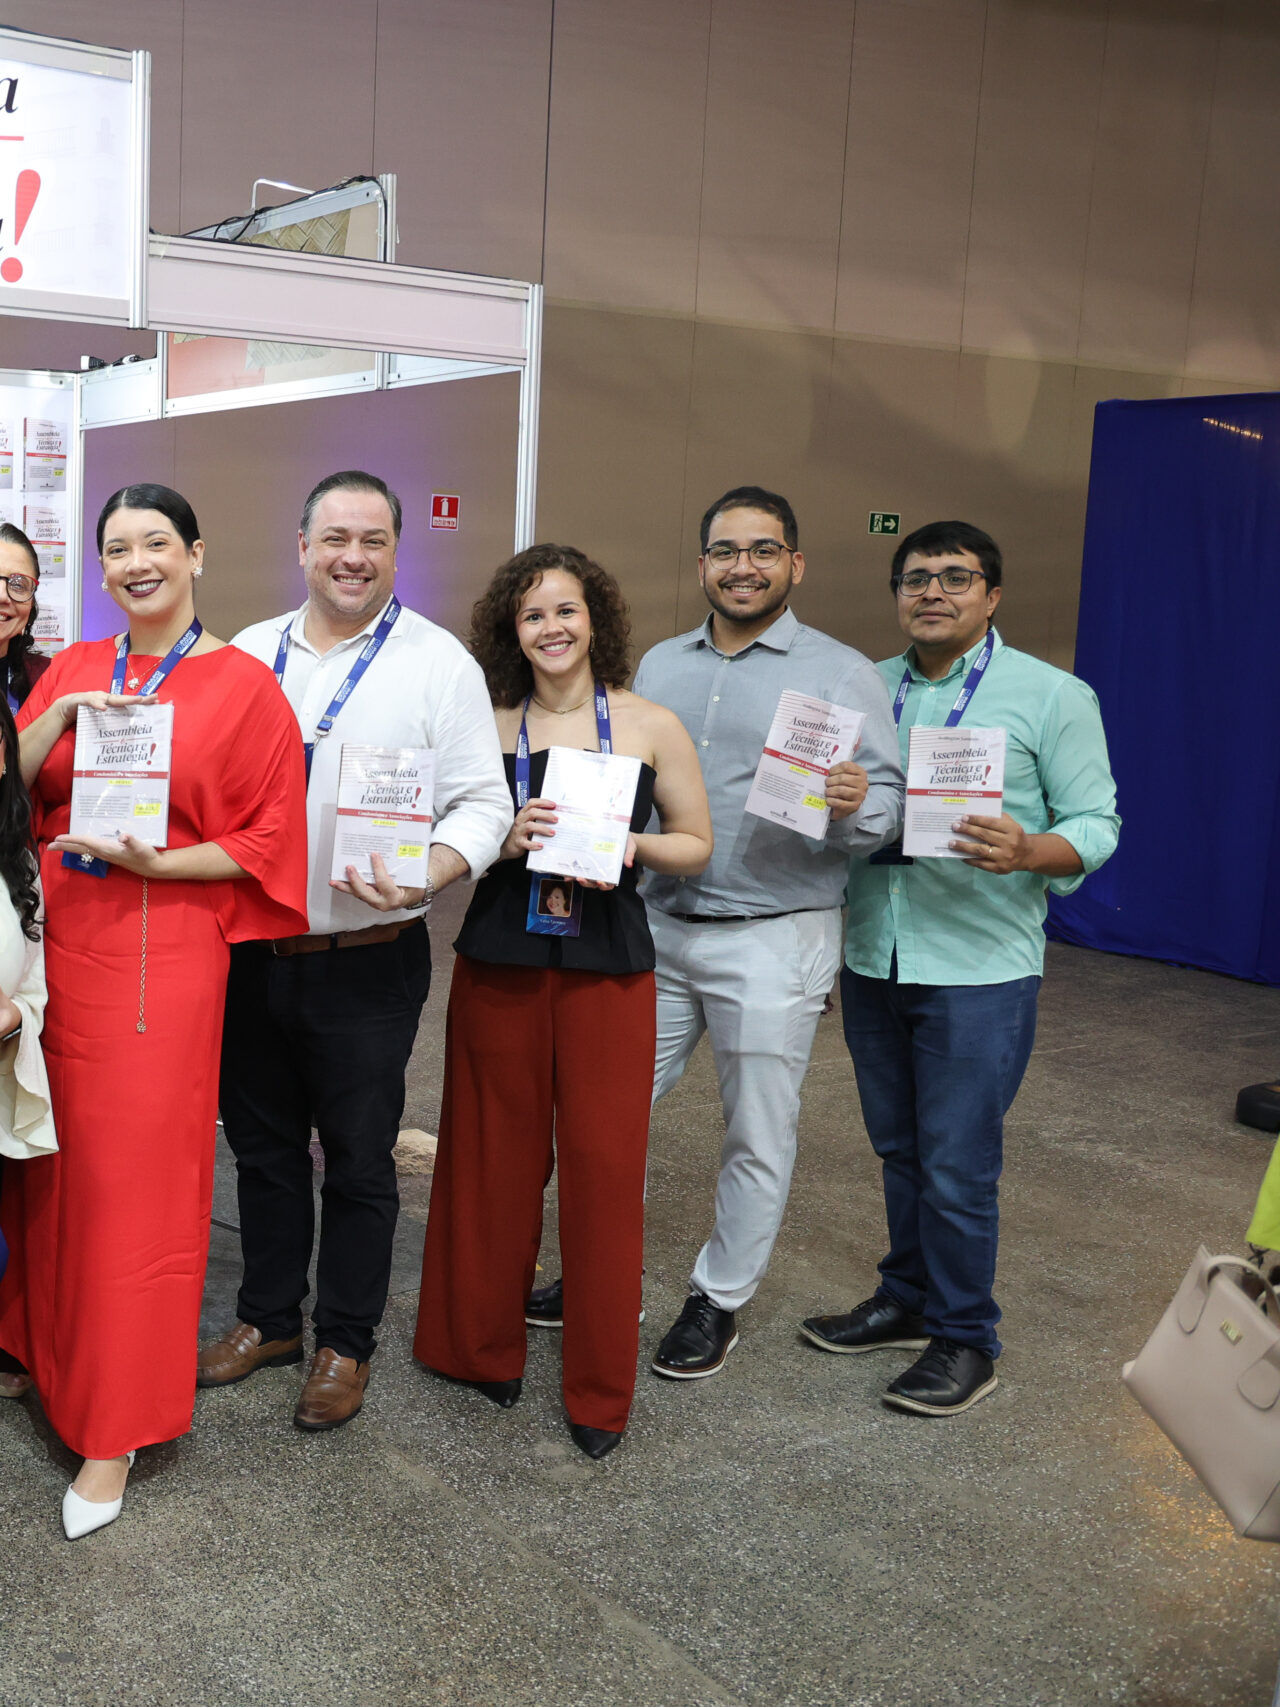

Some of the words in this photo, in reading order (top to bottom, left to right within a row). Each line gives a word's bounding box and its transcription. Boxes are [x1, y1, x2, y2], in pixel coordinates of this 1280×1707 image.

[96, 724, 152, 739] Assembleia
[791, 717, 840, 735] Assembleia
[790, 731, 824, 748] Técnica
[100, 743, 138, 755] Técnica
[929, 747, 987, 760] Assembleia
[934, 765, 973, 776] Técnica
